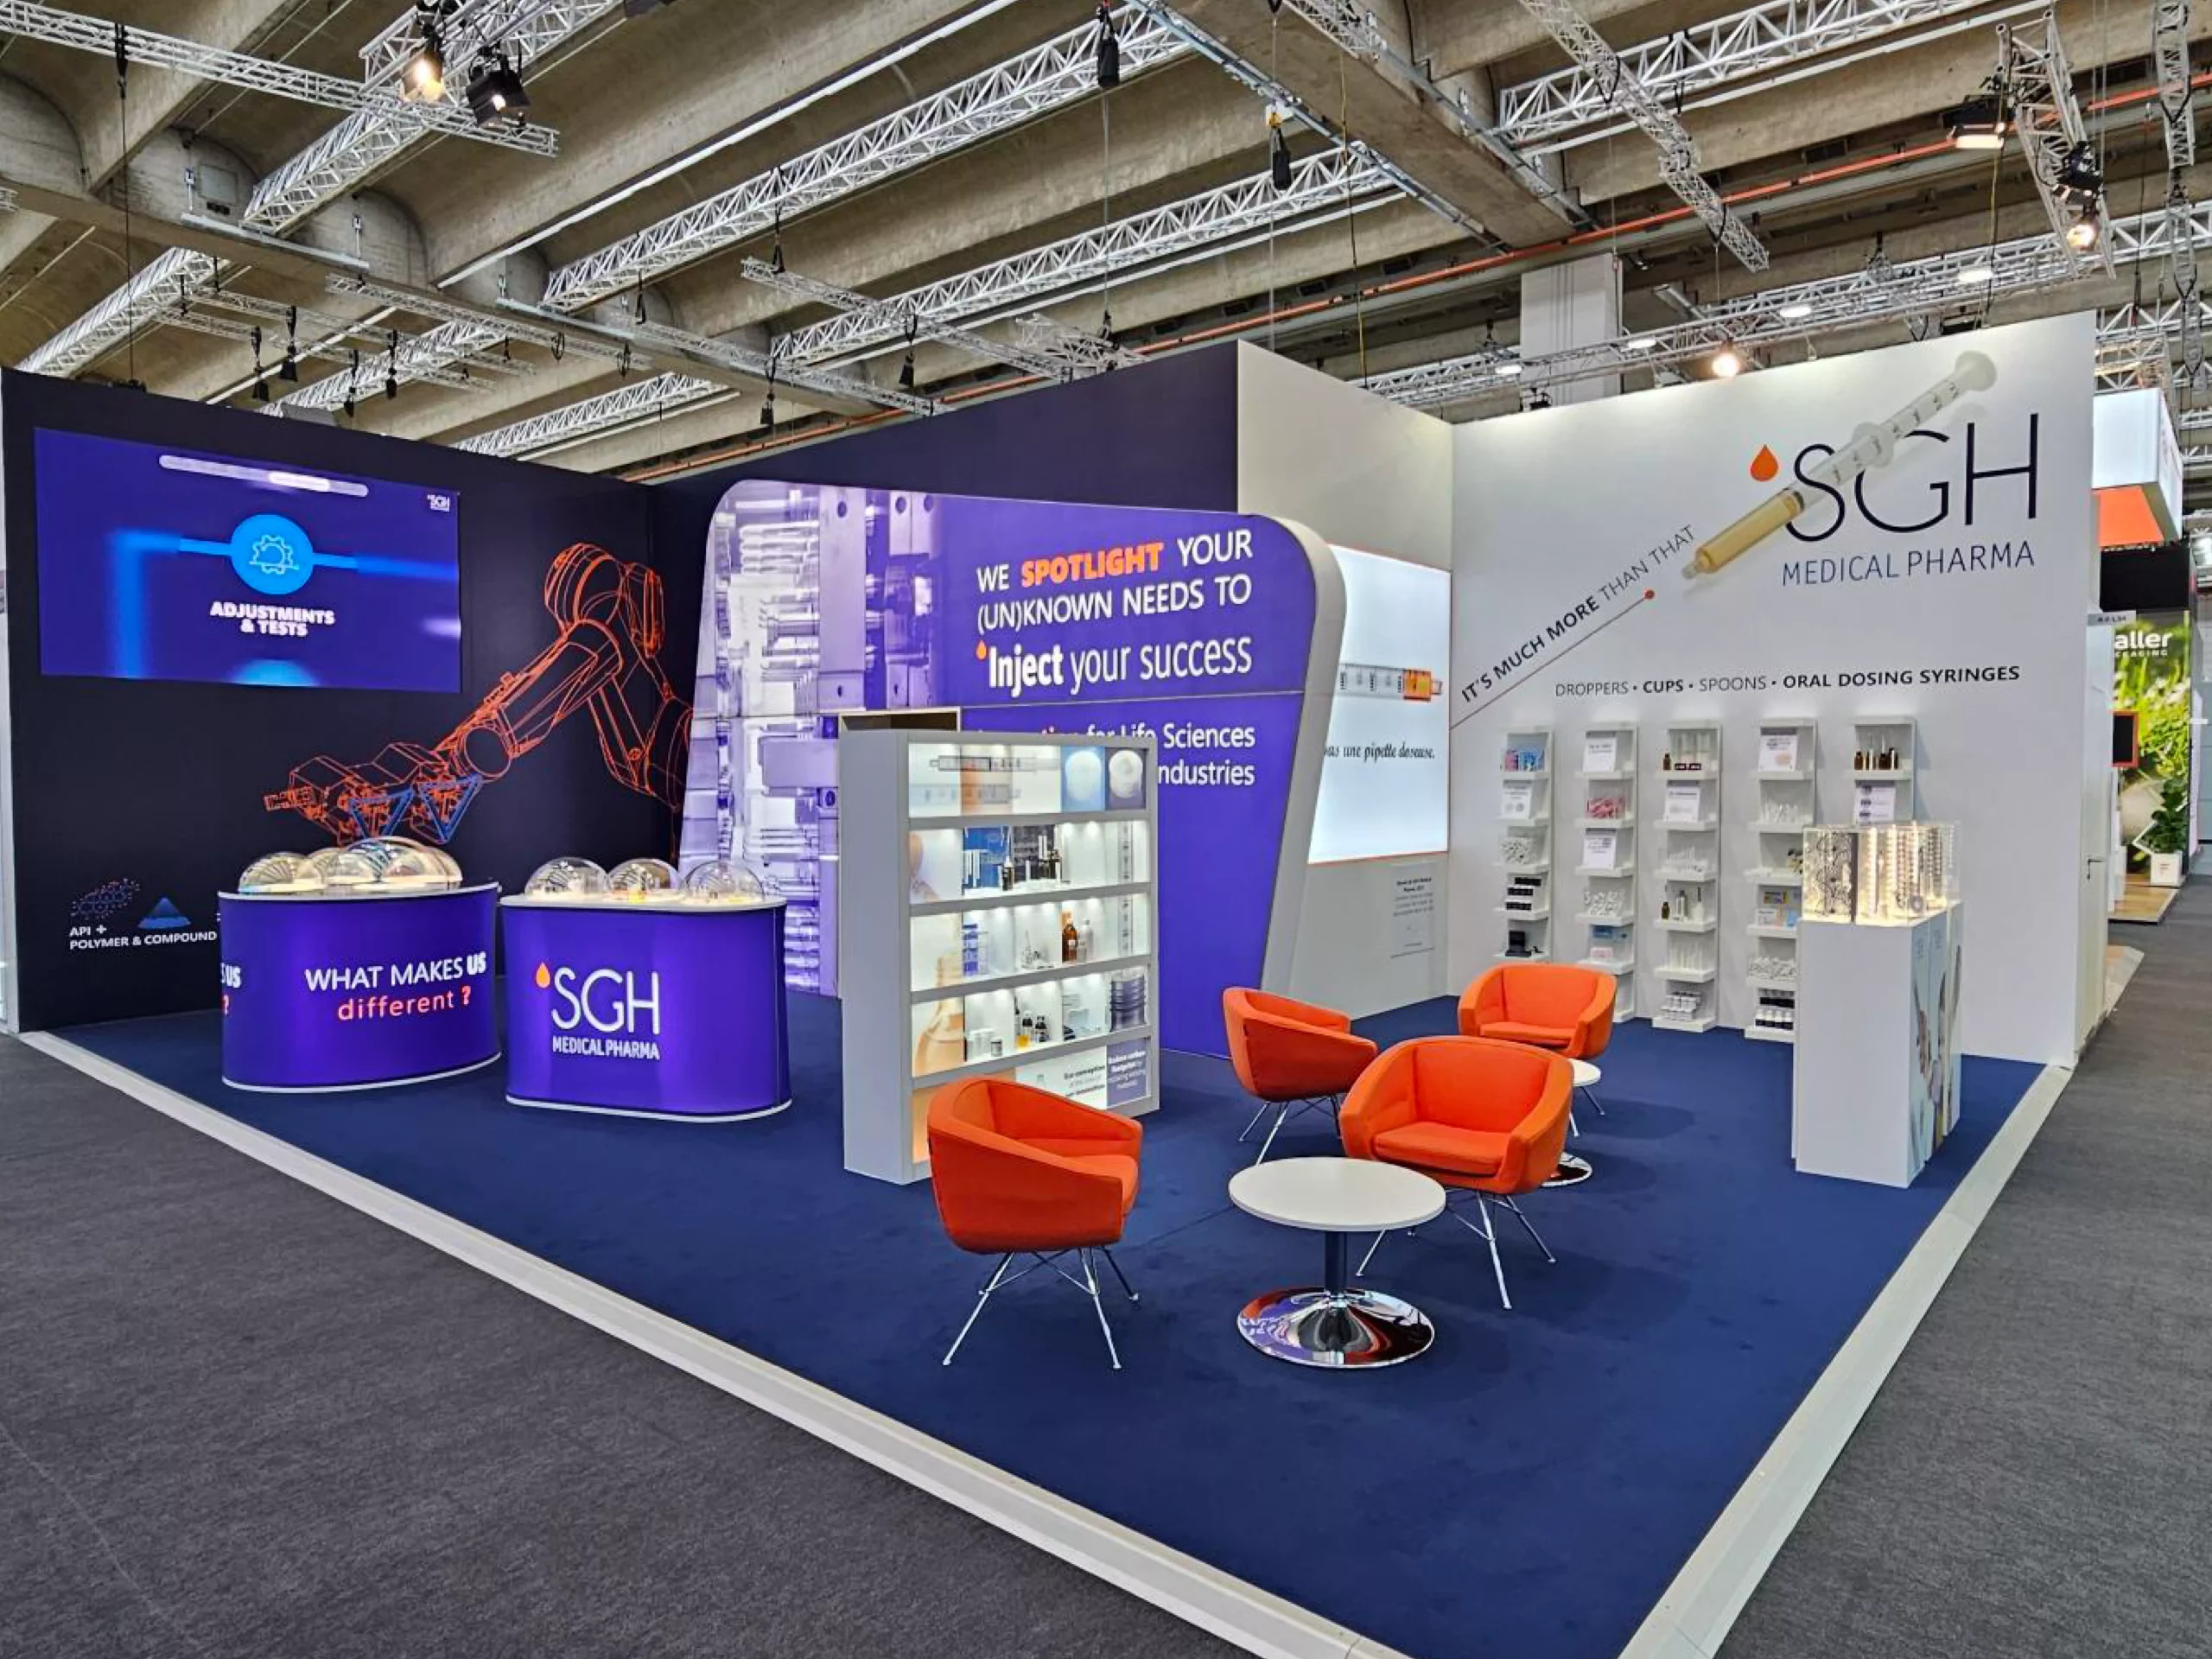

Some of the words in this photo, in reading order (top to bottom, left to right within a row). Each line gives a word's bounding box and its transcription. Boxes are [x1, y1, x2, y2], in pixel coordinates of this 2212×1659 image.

[1785, 412, 2039, 543] SGH
[976, 564, 1010, 594] WE
[1020, 542, 1165, 588] SPOTLIGHT
[1177, 529, 1254, 567] YOUR
[1783, 552, 1899, 588] MEDICAL
[1907, 540, 2035, 576] PHARMA
[210, 601, 335, 625] ADJUSTMENTS
[976, 591, 1113, 635] (UN)KNOWN
[1123, 579, 1205, 617] NEEDS
[1214, 574, 1253, 607] TO
[1461, 672, 1493, 702] IT'S
[1492, 635, 1546, 681] MUCH
[1546, 595, 1600, 642] MORE
[1599, 560, 1649, 601] THAN
[1648, 524, 1697, 566] THAT
[239, 620, 255, 635] &
[257, 620, 308, 638] TESTS
[988, 643, 1065, 698] Inject
[1070, 645, 1131, 696] your
[1139, 636, 1253, 681] success
[1555, 681, 1629, 697] DROPPERS
[1643, 678, 1684, 694] CUPS
[1699, 676, 1767, 693] SPOONS
[1783, 673, 1831, 690] ORAL
[1838, 670, 1913, 688] DOSING
[1919, 665, 2021, 684] SYRINGES
[1163, 721, 1255, 749] Sciences
[1158, 757, 1255, 787] ndustries
[69, 926, 92, 938] API
[69, 937, 129, 950] POLYMER
[132, 936, 142, 946] &
[144, 931, 218, 946] COMPOUND
[226, 965, 241, 988] US
[304, 966, 384, 992] WHAT
[390, 957, 464, 987] MAKES
[467, 951, 486, 976] US
[338, 990, 455, 1021] different
[461, 985, 472, 1006] ?
[551, 967, 660, 1035] SGH
[552, 1035, 605, 1056] MEDICAL
[606, 1039, 661, 1061] PHARMA
